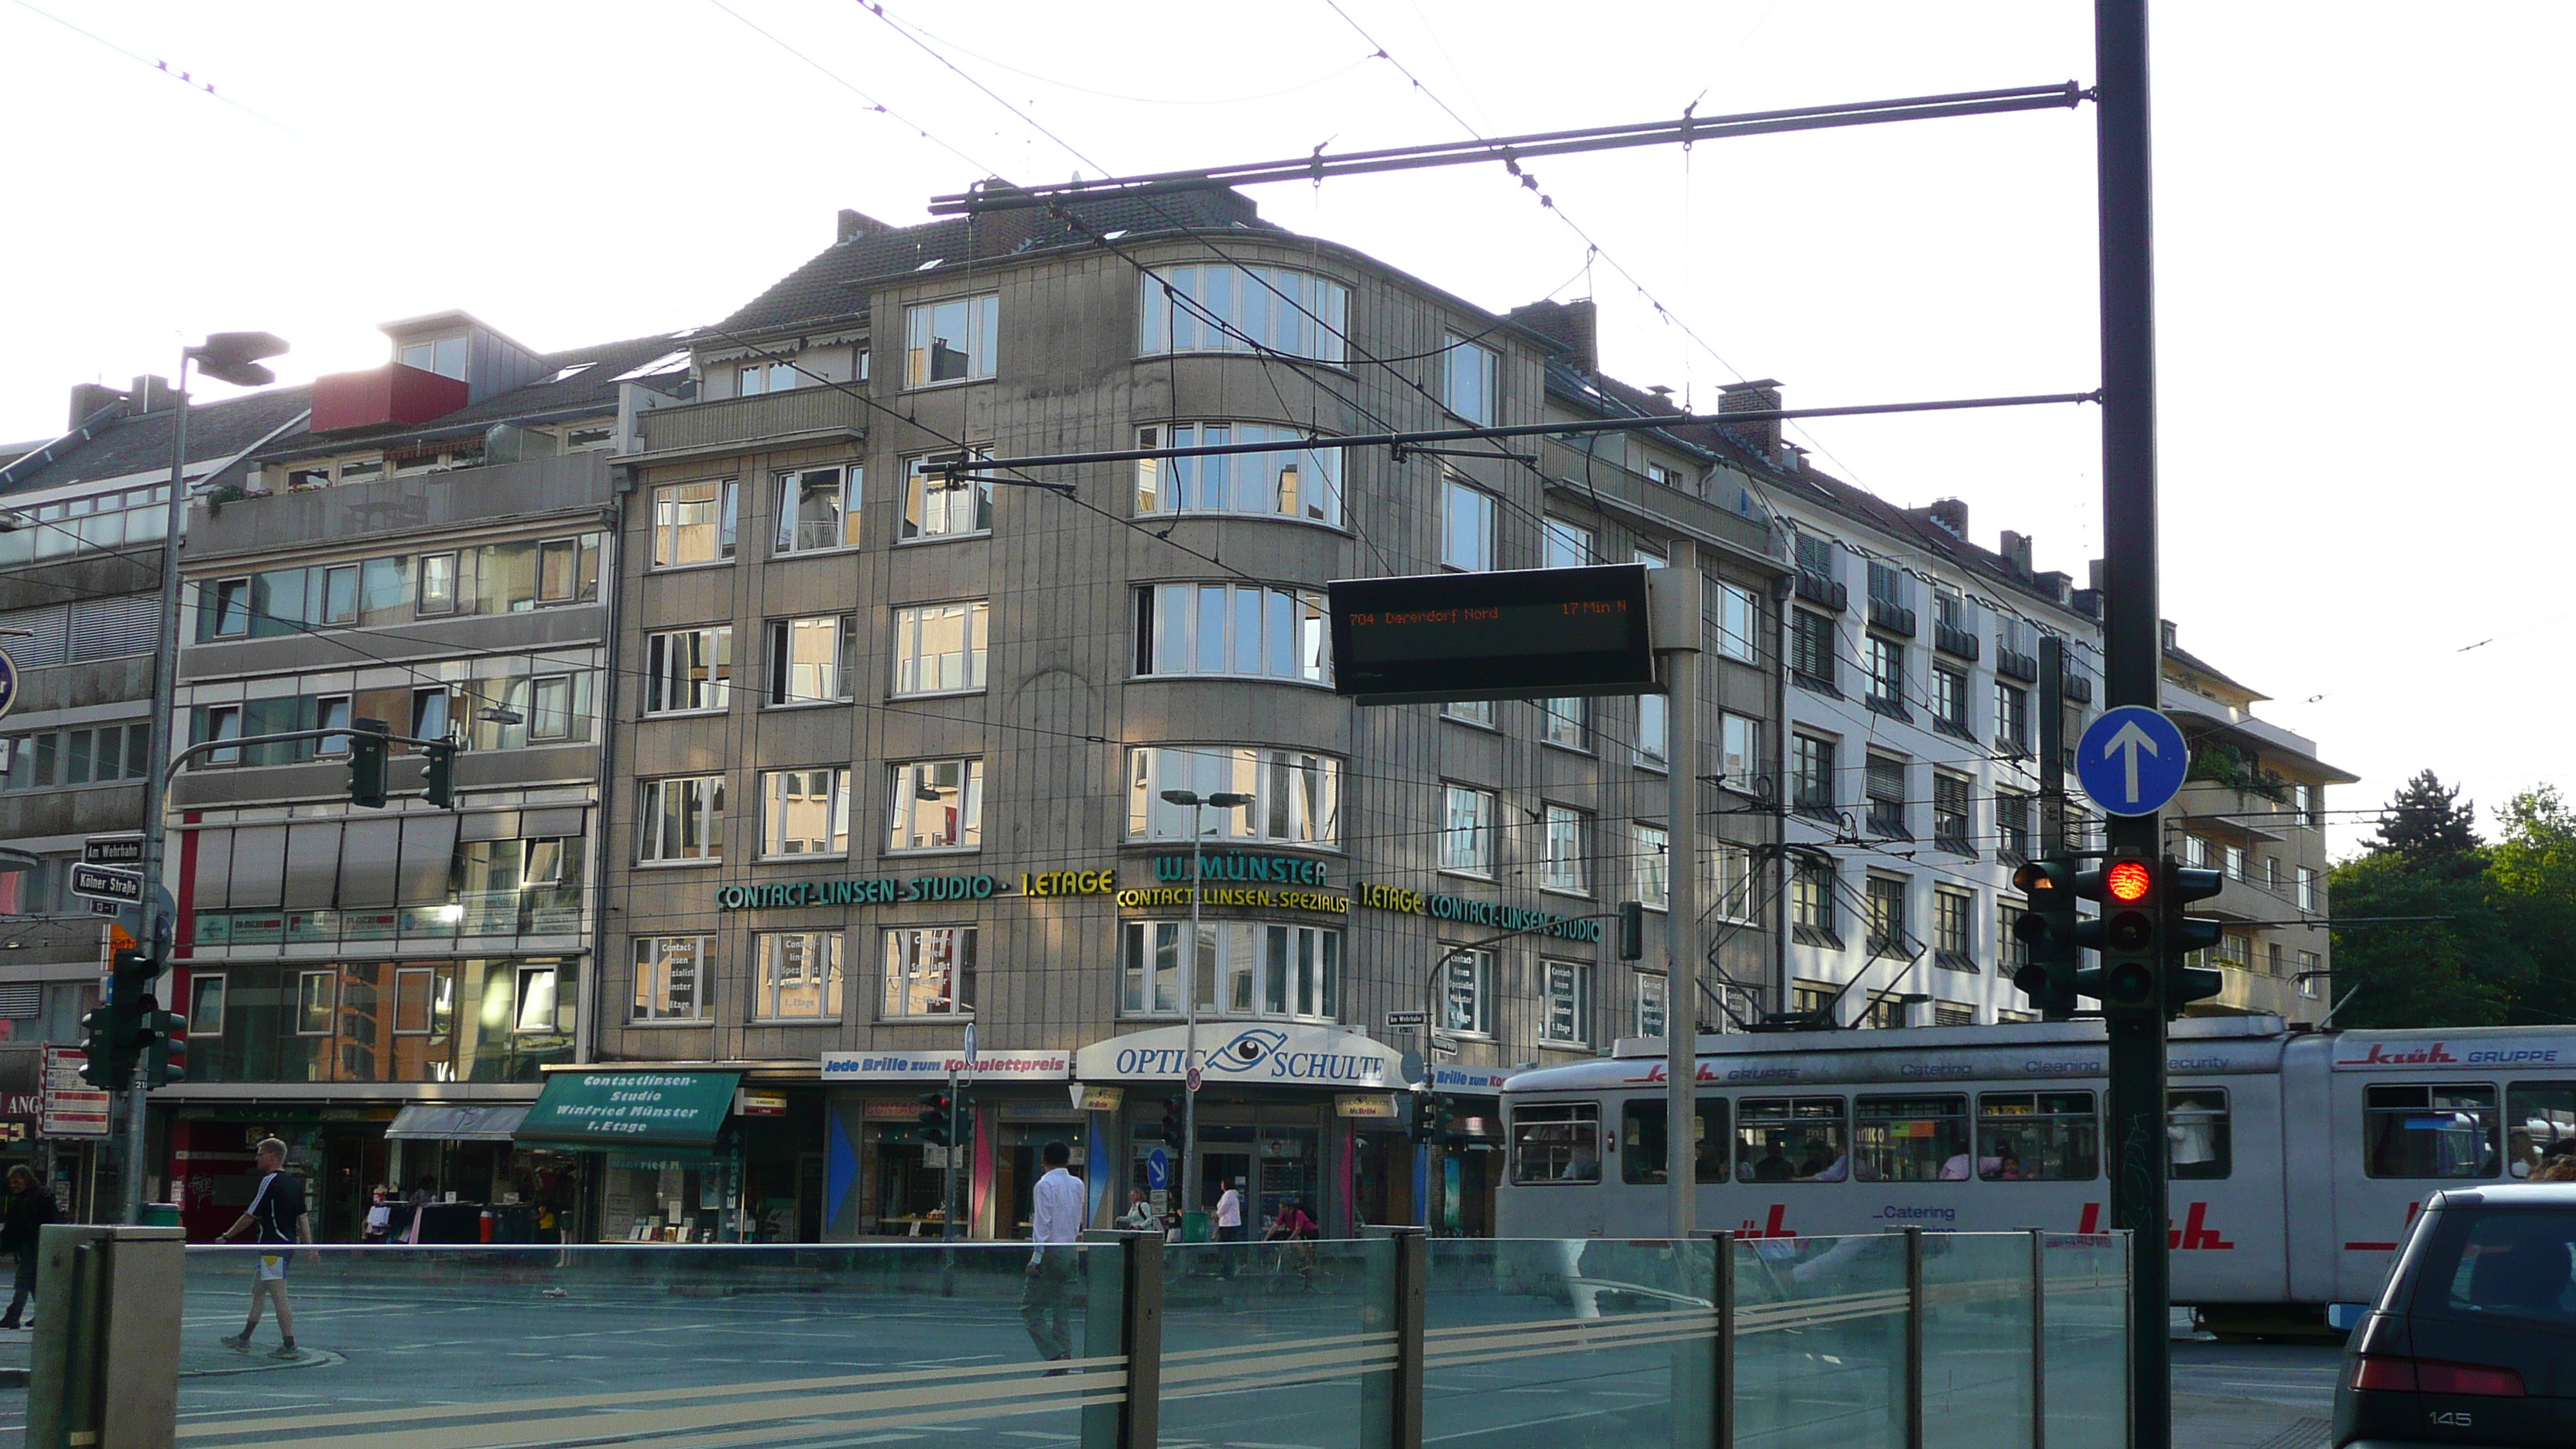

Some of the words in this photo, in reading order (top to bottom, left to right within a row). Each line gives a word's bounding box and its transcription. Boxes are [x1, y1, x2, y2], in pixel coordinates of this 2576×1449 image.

[1349, 614, 1375, 626] 704
[1386, 609, 1458, 625] Derendorf
[1464, 607, 1499, 620] Nord
[1563, 602, 1578, 615] 17
[1583, 601, 1610, 615] Min
[87, 845, 99, 858] Am
[102, 844, 138, 858] Wehrhahn
[80, 873, 107, 889] Kölner
[110, 877, 137, 896] Straße
[662, 943, 695, 952] Contact-
[670, 1000, 690, 1011] Etage
[2167, 1055, 2229, 1070] ecurity
[2467, 1050, 2559, 1064] GRUPPE
[824, 1059, 859, 1073] Jede
[862, 1057, 908, 1072] Brille
[911, 1060, 941, 1072] zum
[1271, 1050, 1386, 1081] SCHULTE
[1899, 1062, 1972, 1077] Catering
[2024, 1060, 2101, 1074] Cleaning
[584, 1075, 698, 1087] Contactlinsen-
[1437, 1070, 1468, 1086] Brille
[1468, 1075, 1488, 1087] zum
[1726, 1067, 1800, 1081] GRUPPE
[610, 1091, 662, 1101] Studio
[556, 1105, 626, 1117] Winfried
[629, 1105, 698, 1118] Münster
[2428, 1410, 2472, 1427] 145
